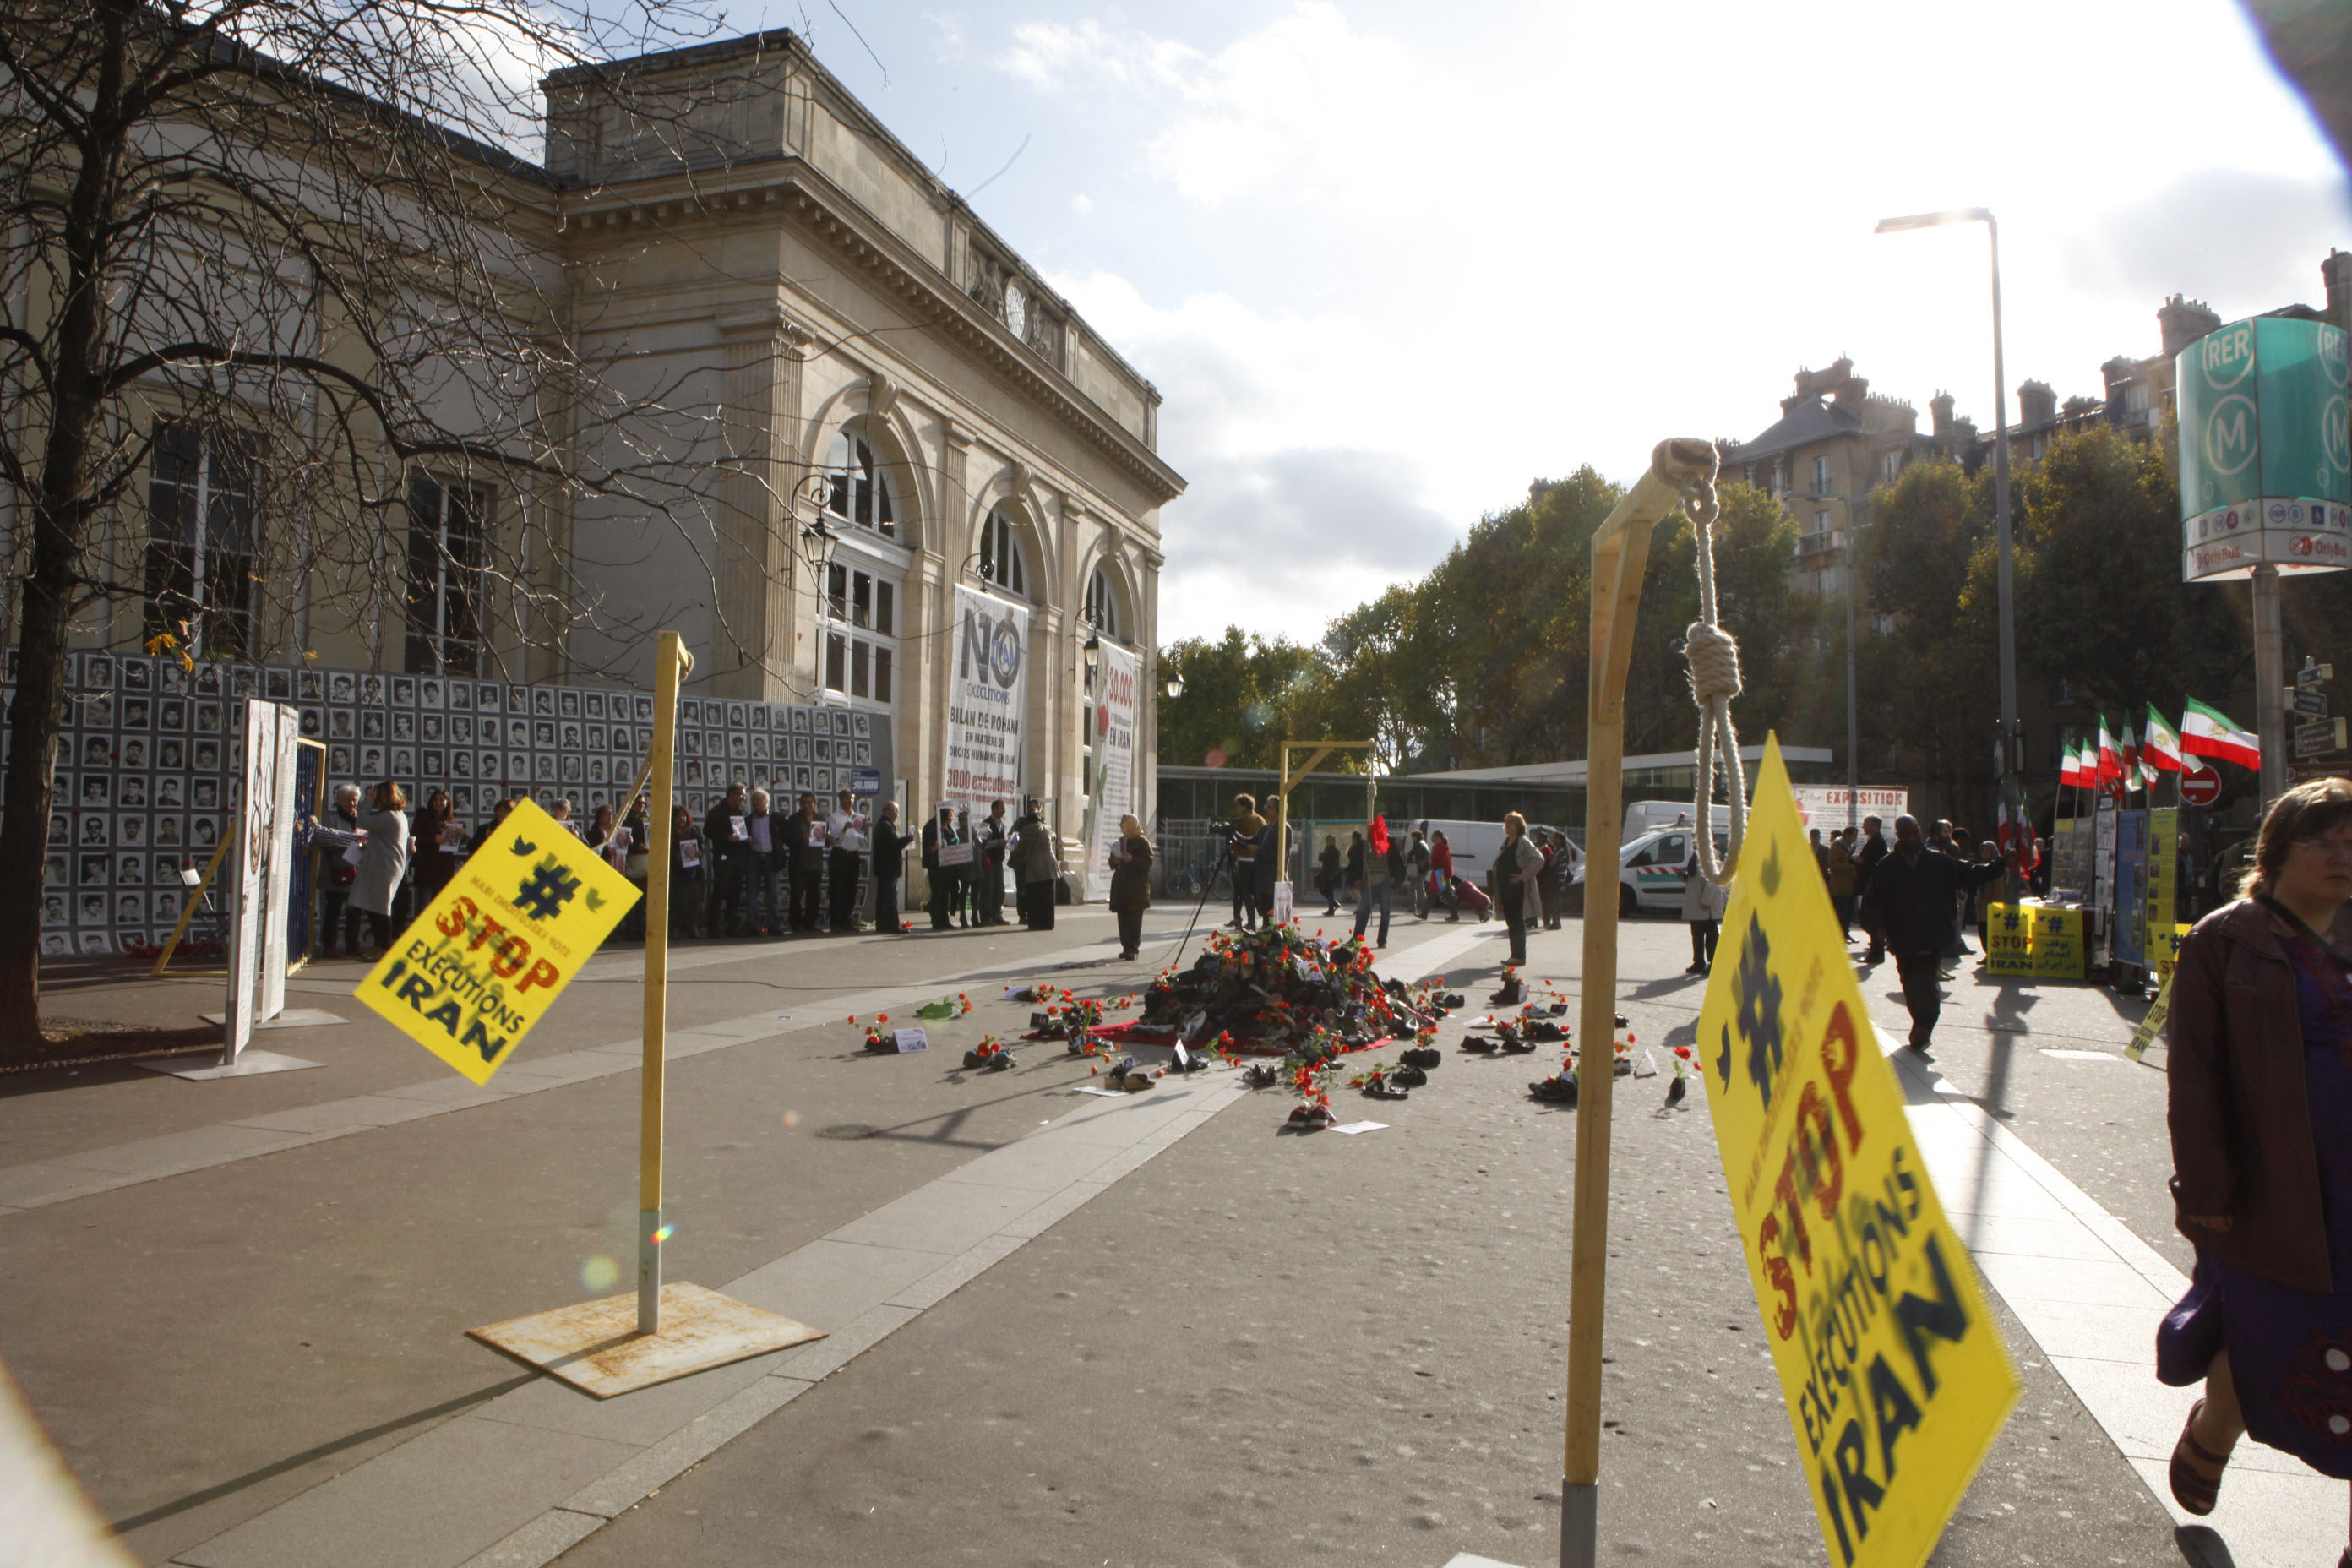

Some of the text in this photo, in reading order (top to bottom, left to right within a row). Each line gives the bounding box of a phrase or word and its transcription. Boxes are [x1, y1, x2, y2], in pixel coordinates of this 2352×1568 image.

[2208, 328, 2250, 371] RER
[2216, 409, 2247, 460] M
[2331, 411, 2349, 458] M
[2204, 547, 2240, 565] OrlyBus
[2316, 542, 2347, 558] OrlyBus
[961, 608, 1021, 689] NO
[966, 683, 1010, 705] EXECUTIONS
[950, 706, 1019, 735] BILAN DE ROHANI
[966, 732, 973, 743] EN
[998, 737, 1005, 749] DE
[1110, 727, 1131, 749] EN IRAN
[950, 745, 970, 759] DROITS
[972, 749, 996, 763] HUMAINS
[947, 769, 971, 790] 3000
[1827, 791, 1903, 805] EXPOSITION
[435, 895, 560, 994] STOP
[1991, 935, 2033, 949] STOP
[1990, 960, 2034, 970] IRAN
[406, 939, 526, 1034] EXECUTIONS
[380, 959, 508, 1064] IRAN
[1759, 1000, 1865, 1342] STOP
[1799, 1145, 1923, 1459] EXECUTIONS
[1821, 1232, 1969, 1568] IRAN
